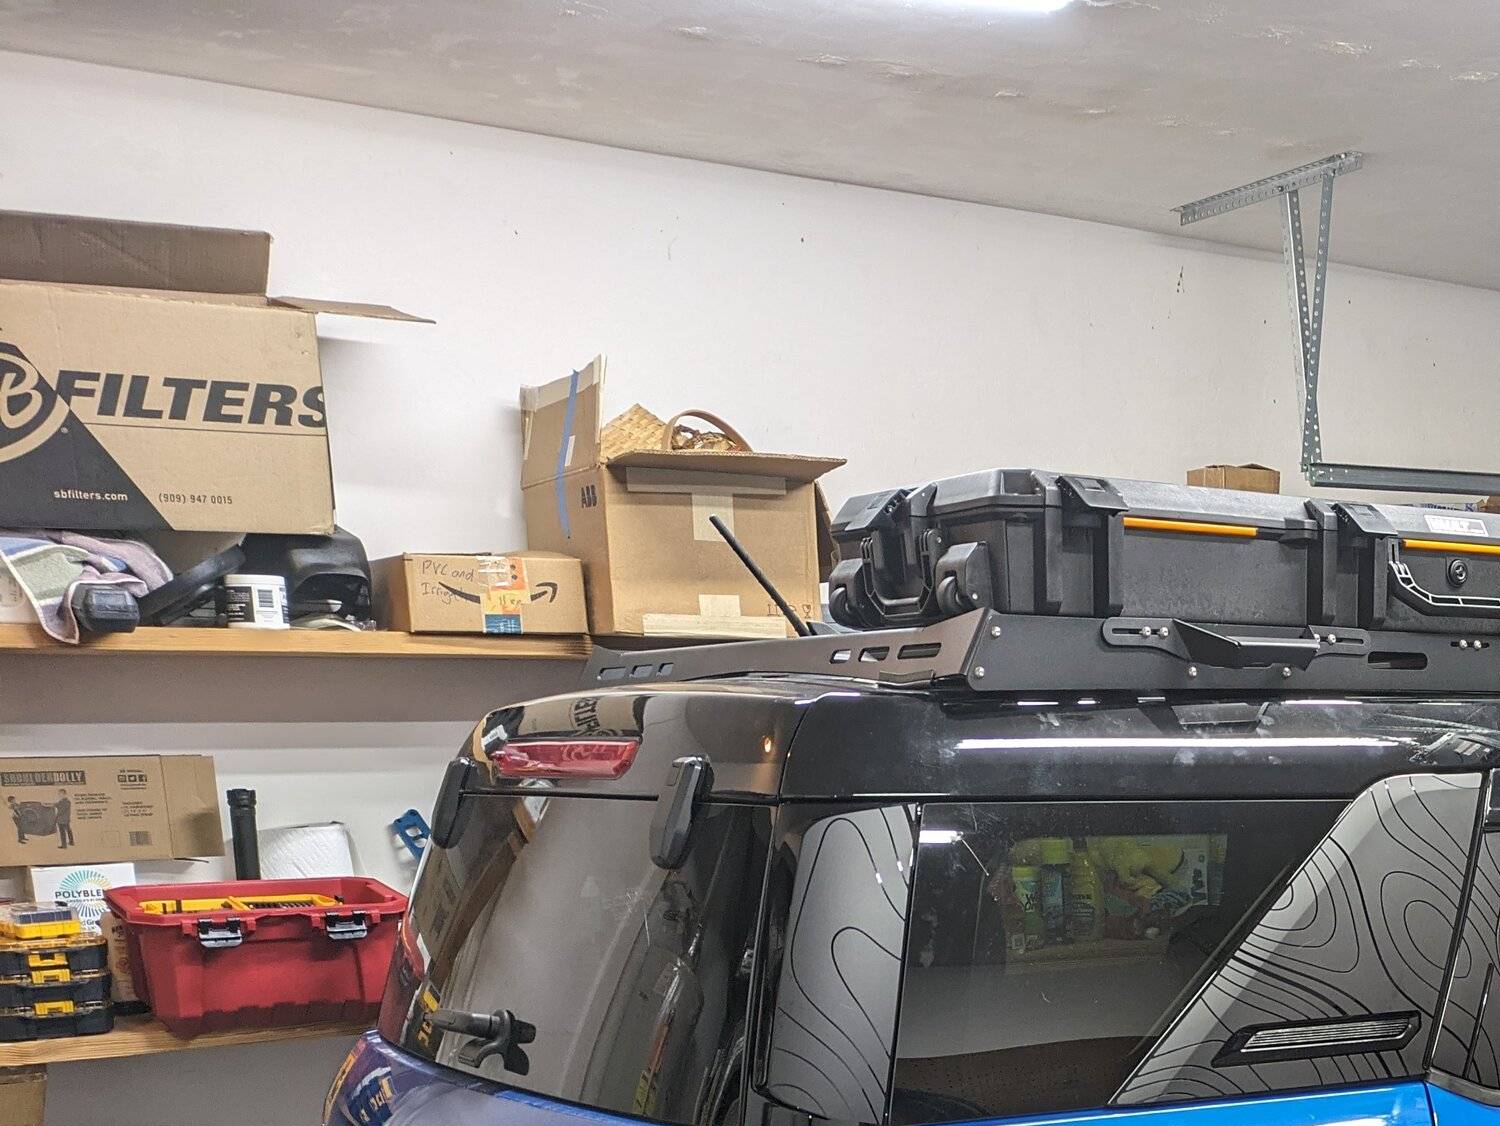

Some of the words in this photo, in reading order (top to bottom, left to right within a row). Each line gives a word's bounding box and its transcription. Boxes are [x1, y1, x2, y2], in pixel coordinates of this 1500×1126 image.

[55, 369, 328, 429] FILTERS
[53, 488, 129, 502] sbfilters.com
[158, 492, 187, 505] (909)
[190, 493, 208, 505] 947
[211, 494, 234, 505] 0015
[580, 484, 598, 509] ABB
[421, 559, 449, 579] PVC
[451, 568, 475, 584] and
[54, 888, 103, 899] POLYBLE
